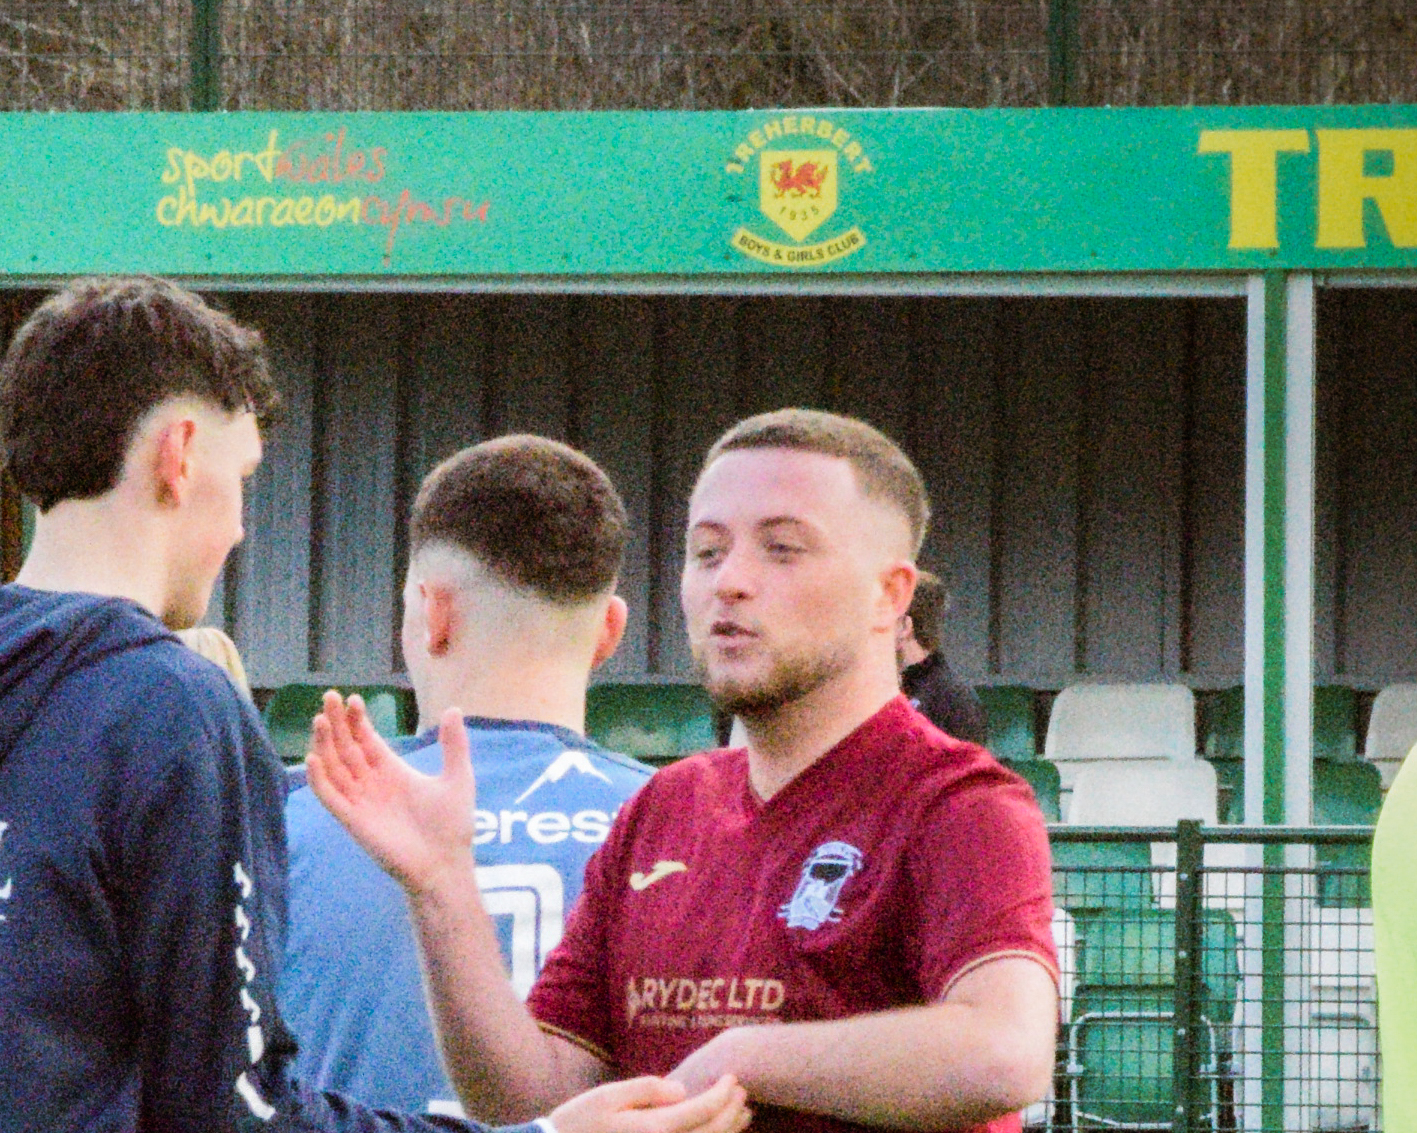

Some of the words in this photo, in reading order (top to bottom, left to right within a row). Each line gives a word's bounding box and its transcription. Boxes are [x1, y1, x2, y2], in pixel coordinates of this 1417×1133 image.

[1197, 128, 1417, 249] TR
[779, 205, 820, 221] 1935
[738, 234, 770, 258] BOYS
[773, 249, 783, 261] &
[786, 249, 825, 263] GIRLS
[827, 233, 860, 256] CLUB
[472, 803, 622, 844] eres
[728, 977, 785, 1010] LTD
